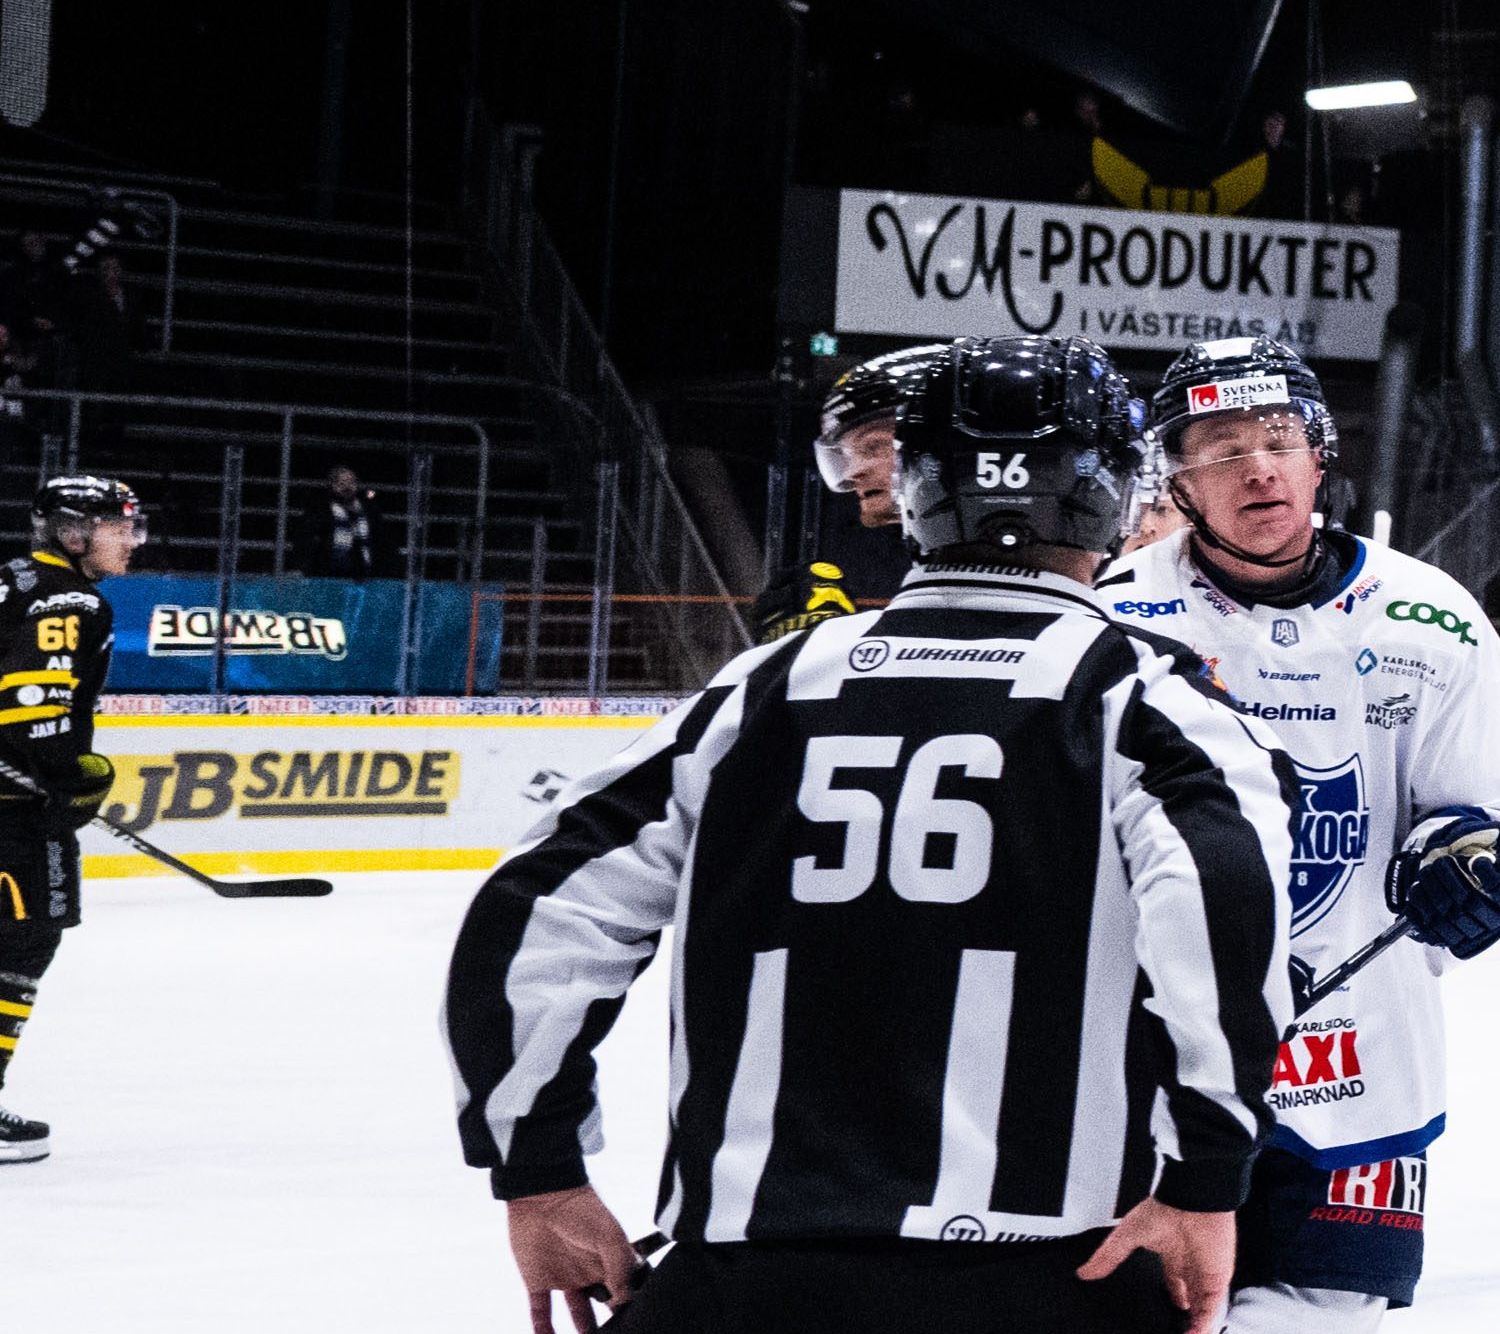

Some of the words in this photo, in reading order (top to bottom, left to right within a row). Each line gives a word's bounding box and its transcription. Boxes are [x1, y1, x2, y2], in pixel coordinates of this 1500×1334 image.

[1222, 380, 1284, 398] SVENSKA
[975, 451, 1030, 490] 56
[1114, 597, 1186, 619] egon
[896, 647, 1026, 665] WARRIOR
[1269, 671, 1321, 683] BAUER
[1243, 701, 1337, 722] Helmia
[109, 748, 238, 832] JB
[244, 750, 454, 803] SMIDE
[792, 733, 1005, 904] 56
[1309, 1206, 1375, 1225] ROAD
